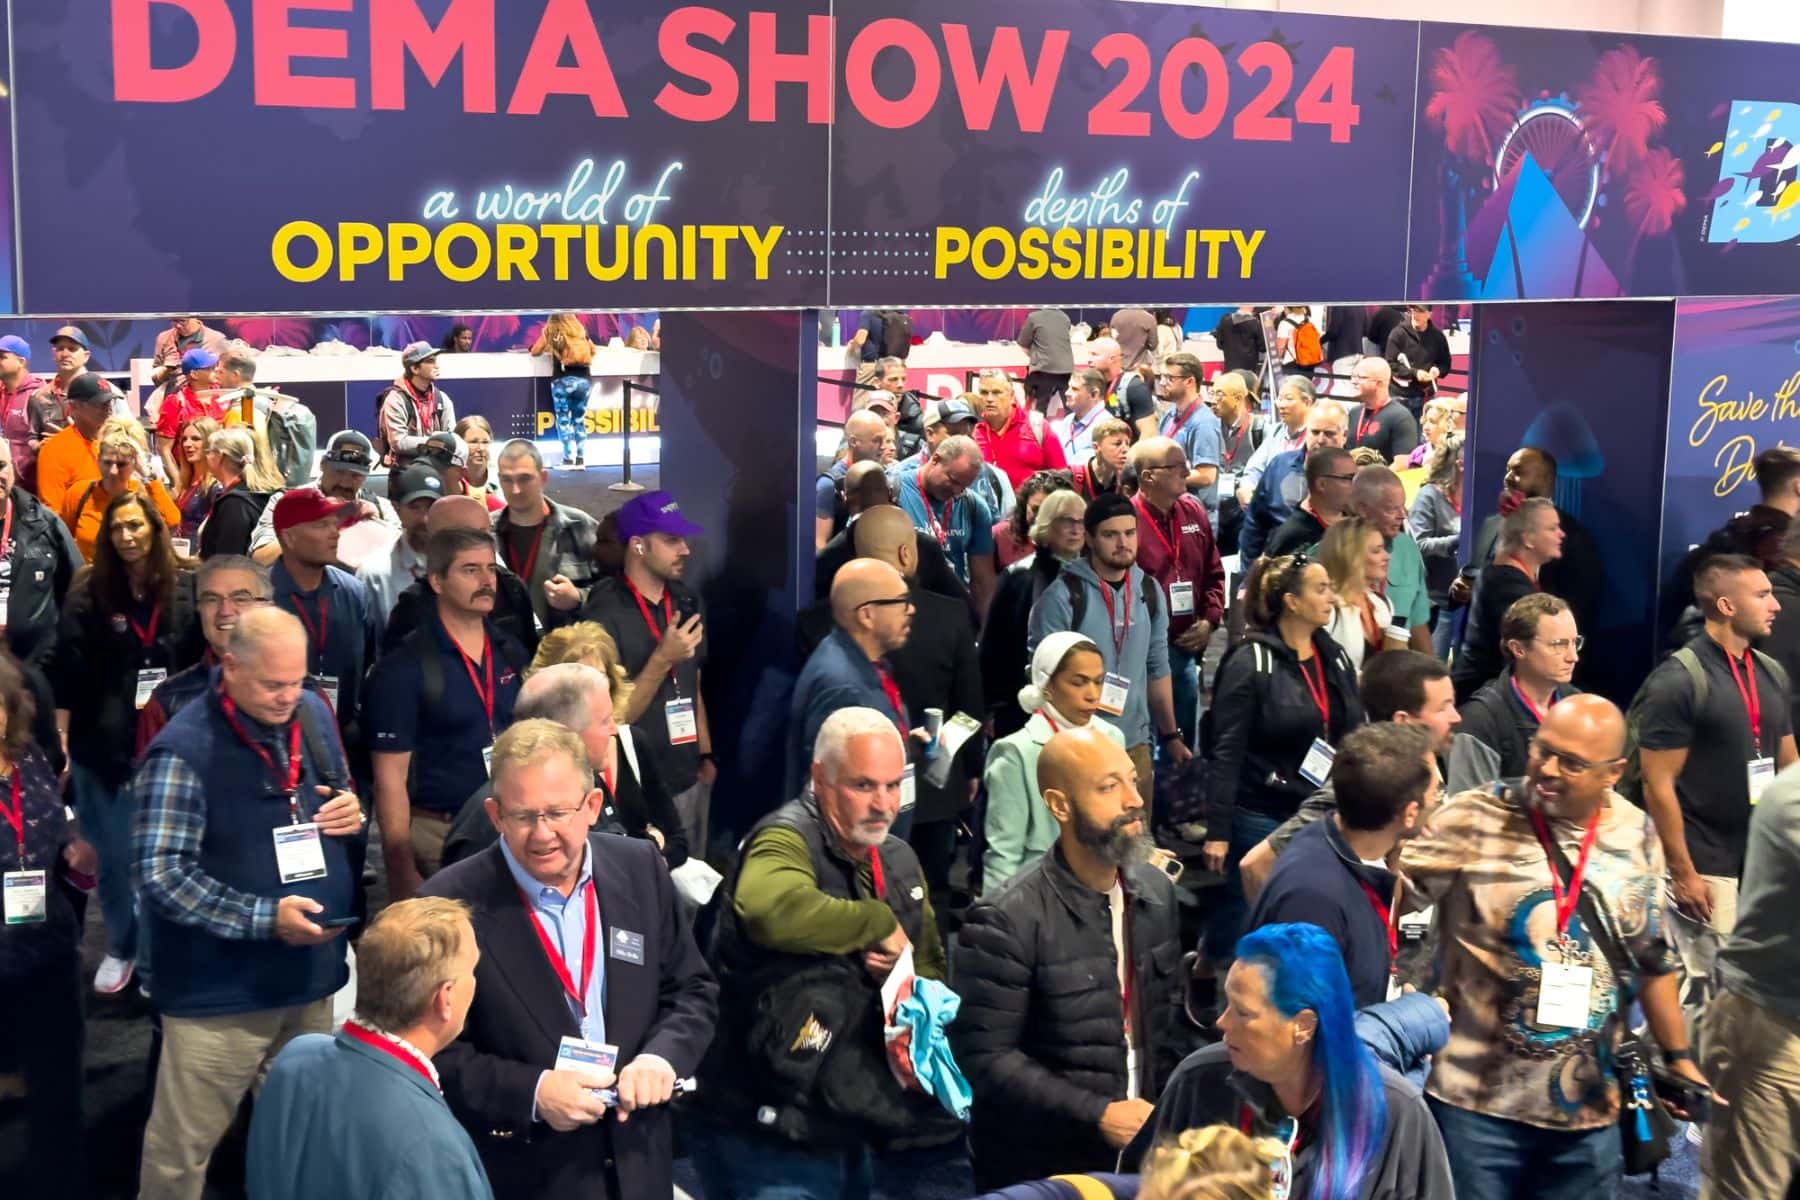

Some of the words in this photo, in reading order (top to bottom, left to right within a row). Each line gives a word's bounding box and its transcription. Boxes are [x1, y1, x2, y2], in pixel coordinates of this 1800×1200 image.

[111, 0, 629, 118] DEMA
[653, 6, 1070, 132] SHOW
[1087, 32, 1360, 143] 2024
[423, 191, 459, 219] a
[475, 158, 626, 225] world
[624, 161, 683, 228] of
[1024, 167, 1143, 229] depths
[1152, 171, 1200, 240] of
[271, 220, 784, 282] OPPORTUNITY
[934, 226, 1266, 280] POSSIBILITY
[537, 407, 660, 436] PSSIBIL
[1689, 374, 1769, 447] Save
[1771, 370, 1800, 422] th
